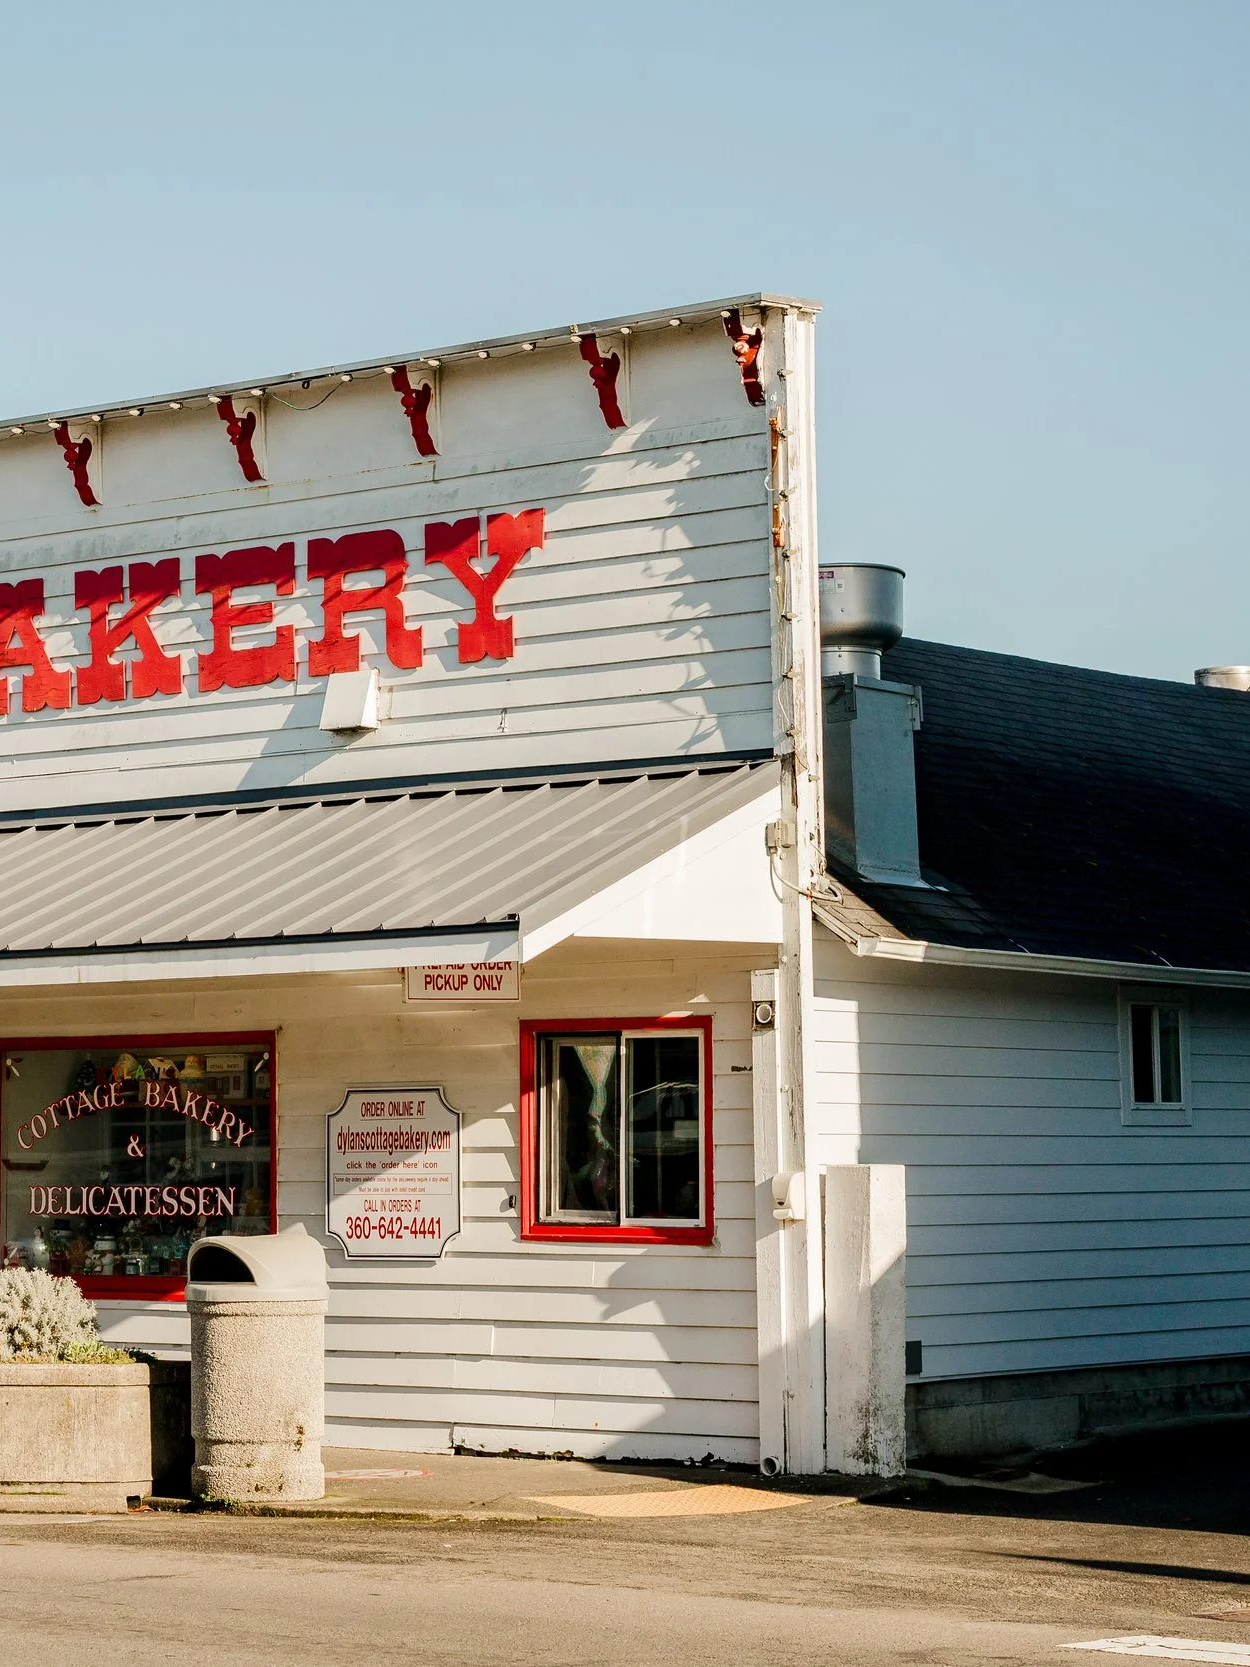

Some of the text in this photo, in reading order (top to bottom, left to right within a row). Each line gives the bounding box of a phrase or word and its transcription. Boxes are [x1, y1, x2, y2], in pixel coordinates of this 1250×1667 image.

[424, 974, 503, 991] PICKUP ONLY
[16, 1080, 254, 1150] COTTAGE BAKERY
[361, 1100, 425, 1117] ORDER ONLINE AT
[126, 1134, 144, 1158] &
[337, 1125, 451, 1155] dylanscottagebakery.com
[346, 1161, 362, 1169] click
[365, 1161, 376, 1169] the
[422, 1161, 438, 1169] icon
[28, 1186, 236, 1217] DELICATESSEN
[364, 1199, 421, 1212] CALL IN ORDERS AT
[346, 1216, 441, 1240] 360-642-4441
